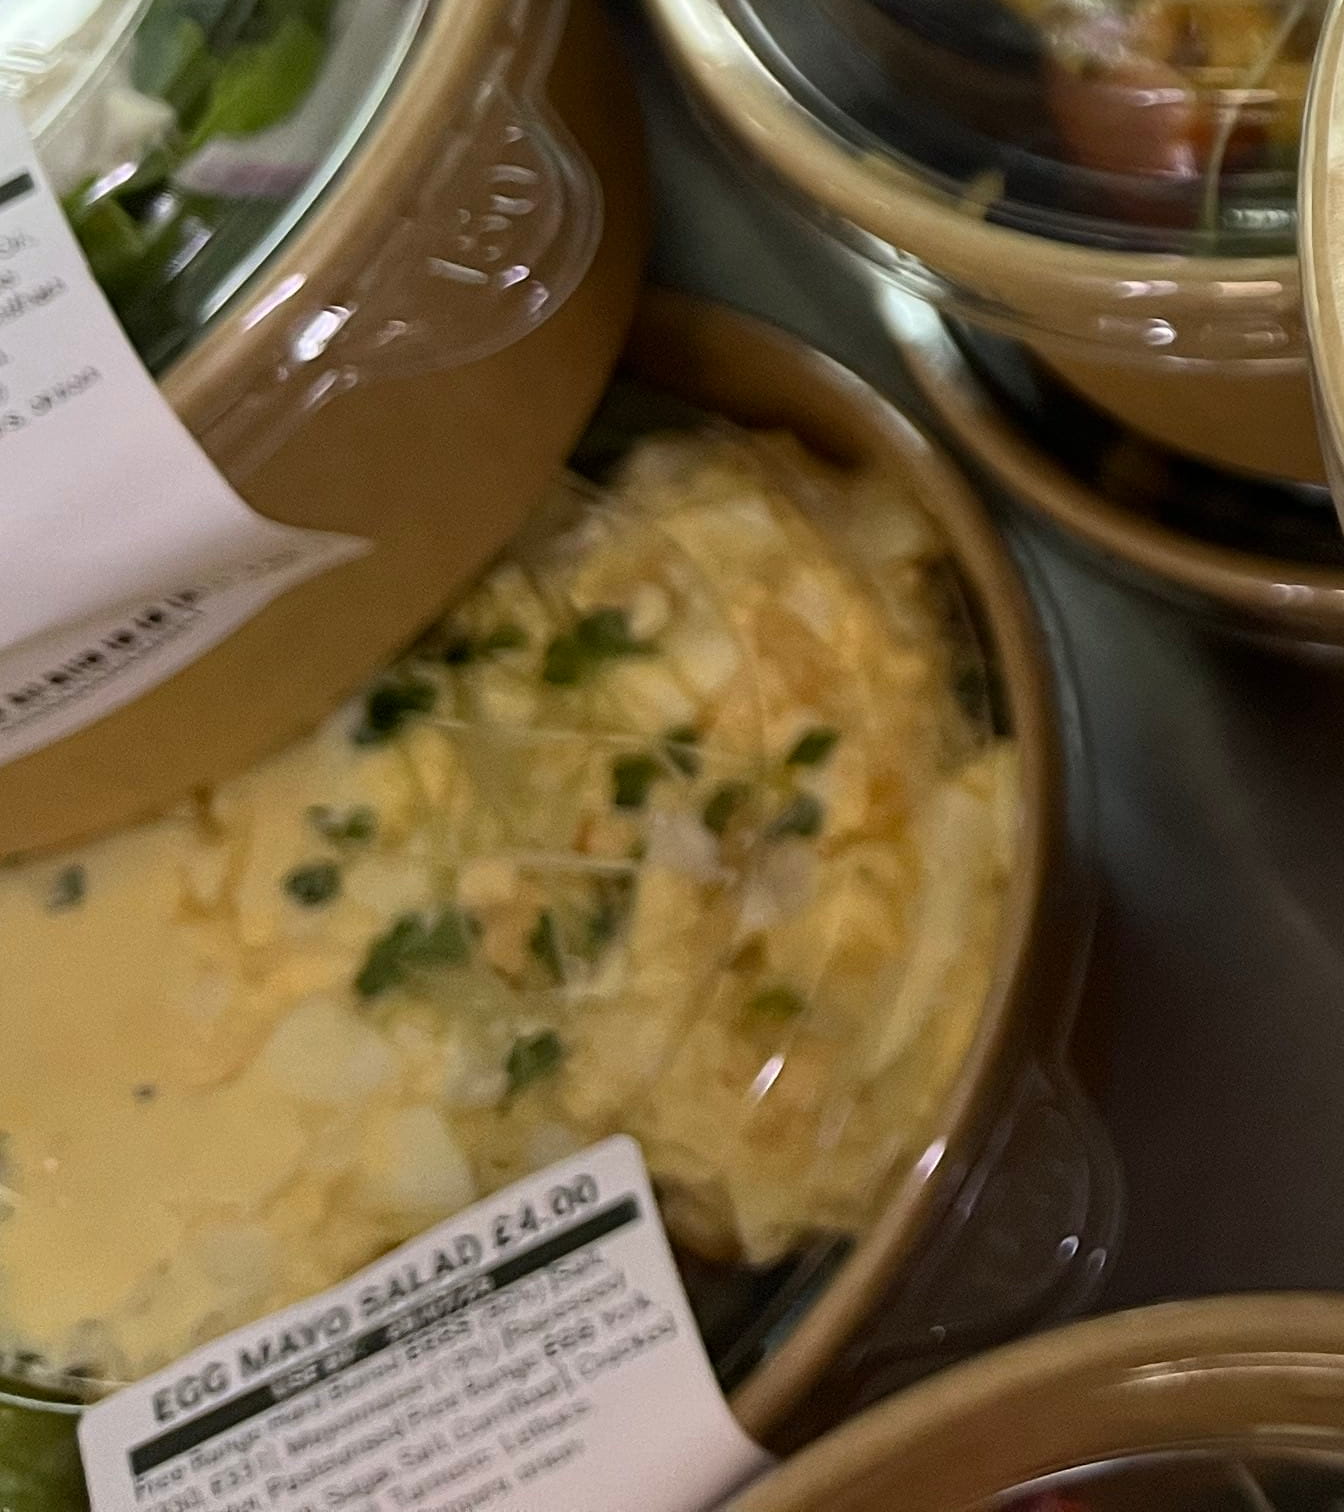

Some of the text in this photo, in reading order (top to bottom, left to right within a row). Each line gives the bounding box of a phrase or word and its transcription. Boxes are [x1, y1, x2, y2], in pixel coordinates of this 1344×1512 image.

[150, 1359, 228, 1424] EGG
[233, 1304, 352, 1379] MAYO
[355, 1232, 484, 1318] SALAD
